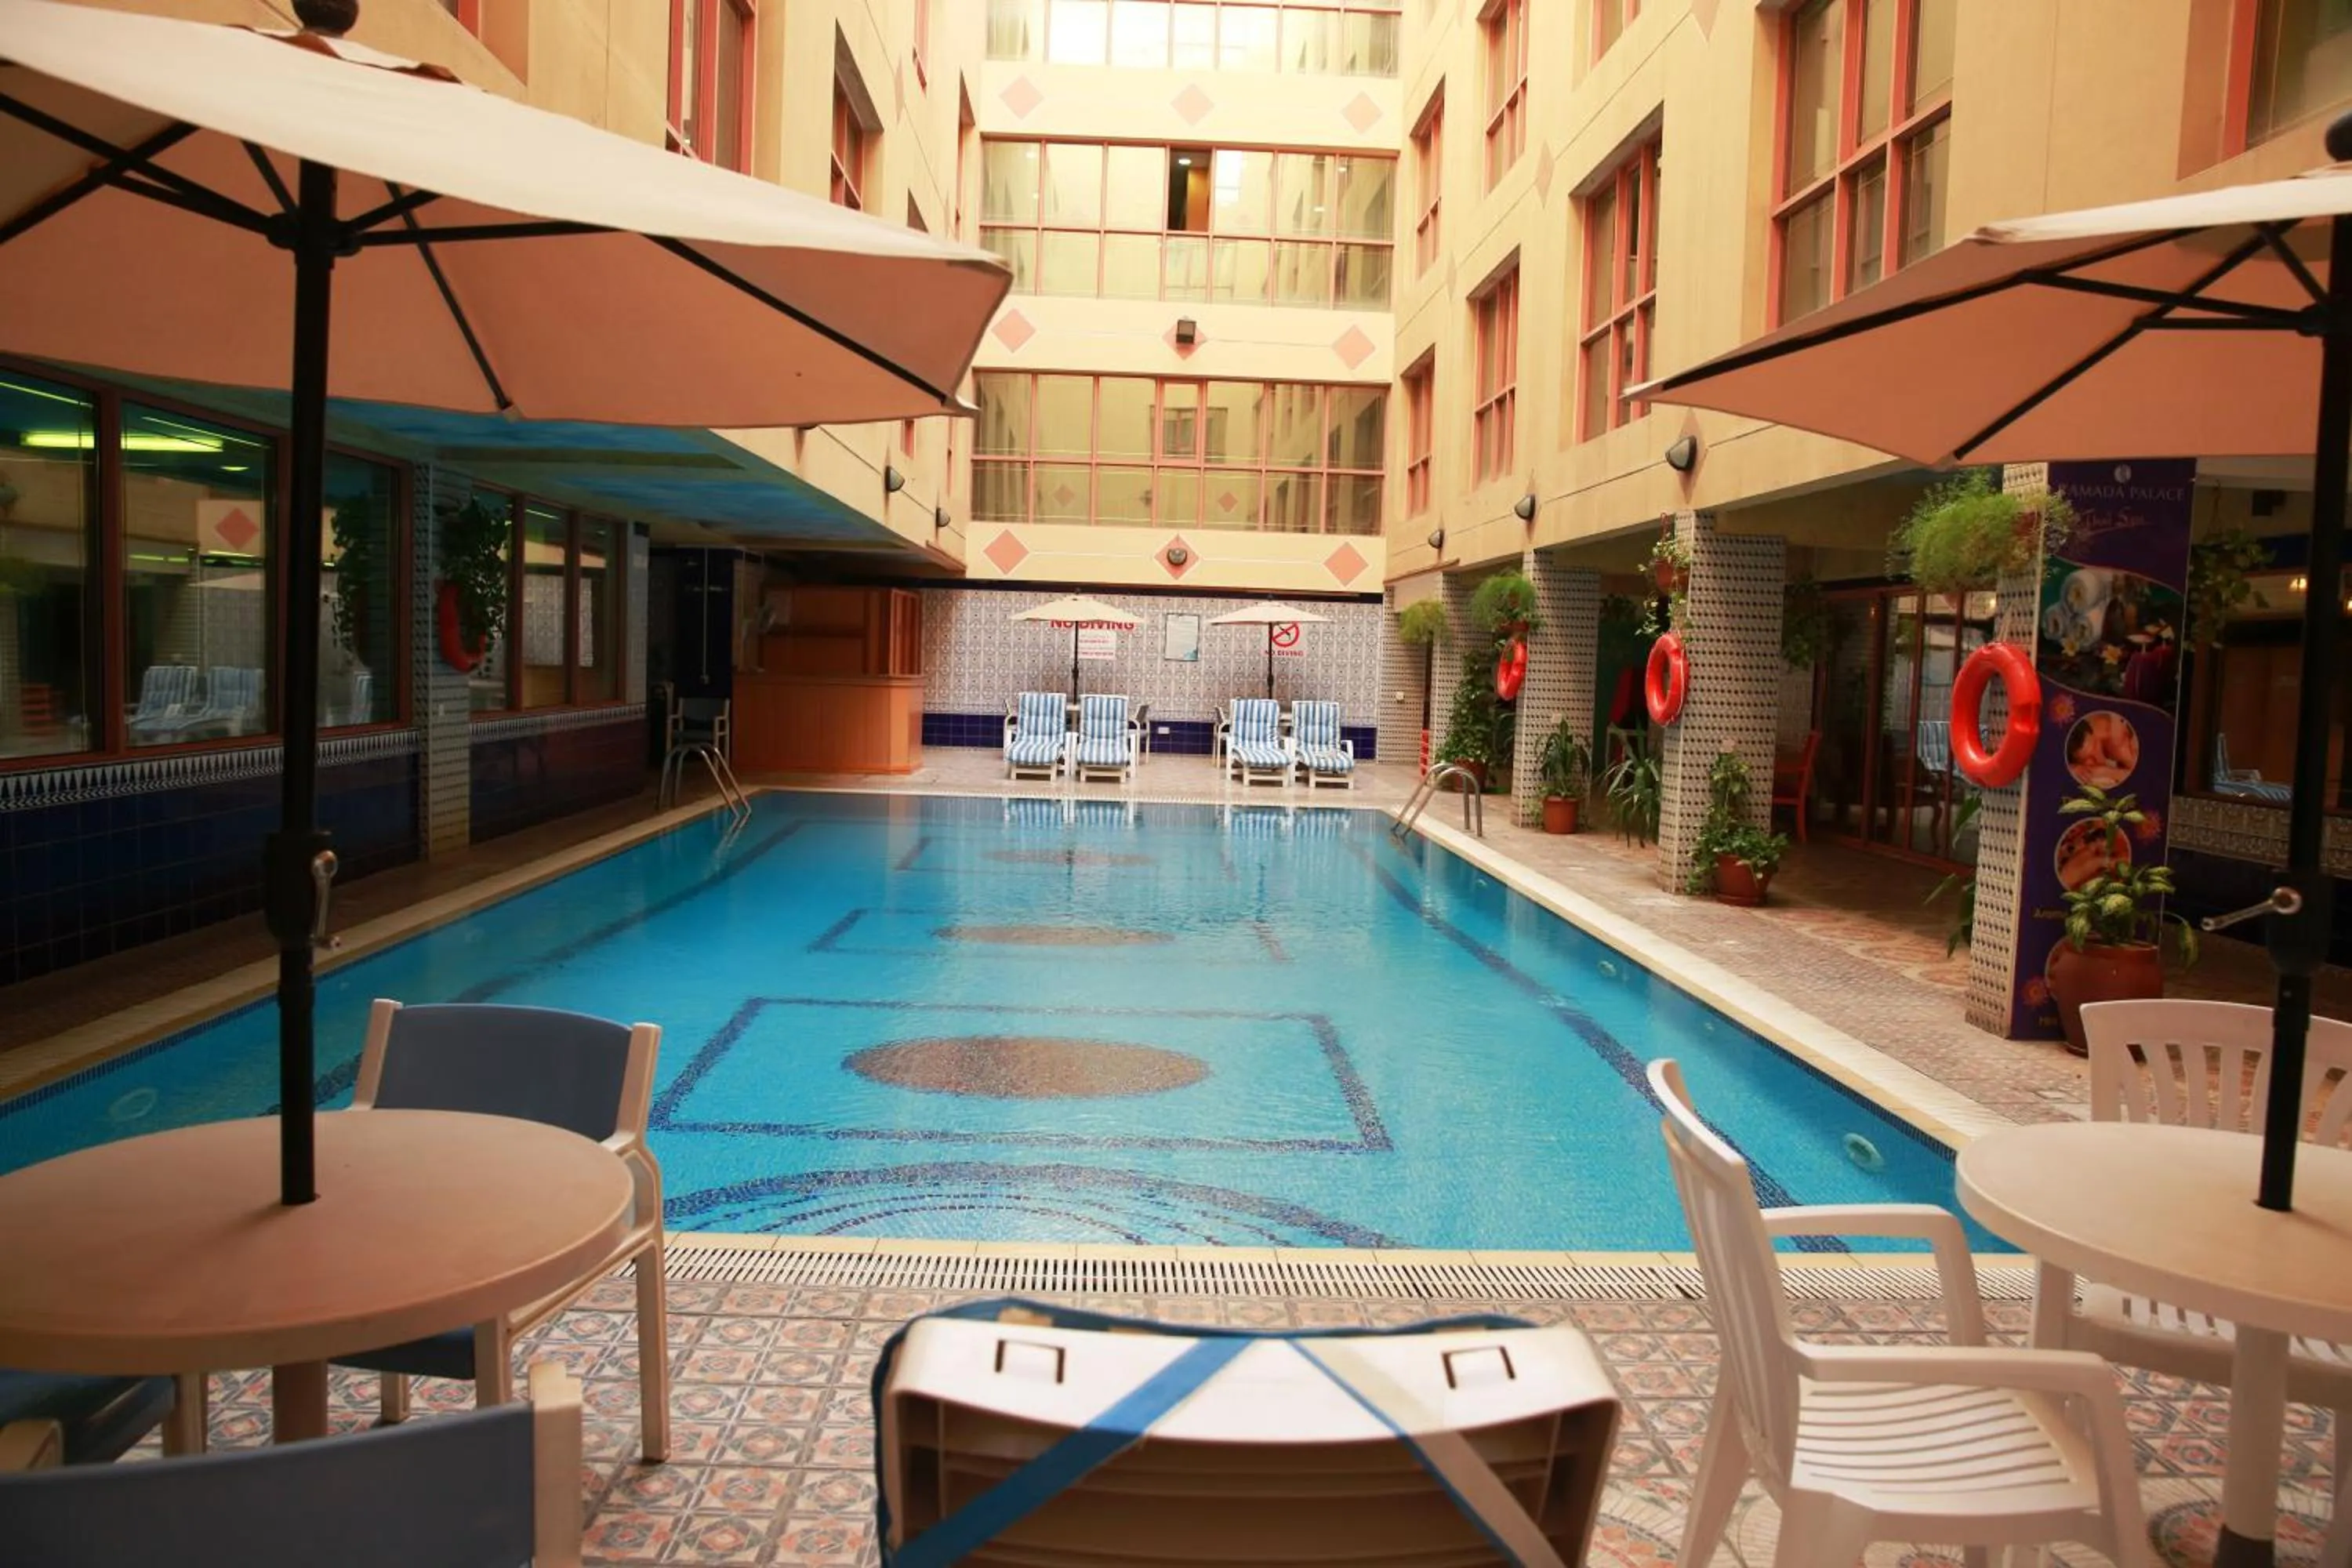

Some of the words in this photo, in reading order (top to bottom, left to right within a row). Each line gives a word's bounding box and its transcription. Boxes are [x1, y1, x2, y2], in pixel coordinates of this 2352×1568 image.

[2129, 485, 2185, 503] PALACE
[1051, 619, 1073, 628] NO
[1078, 619, 1134, 630] DIVING
